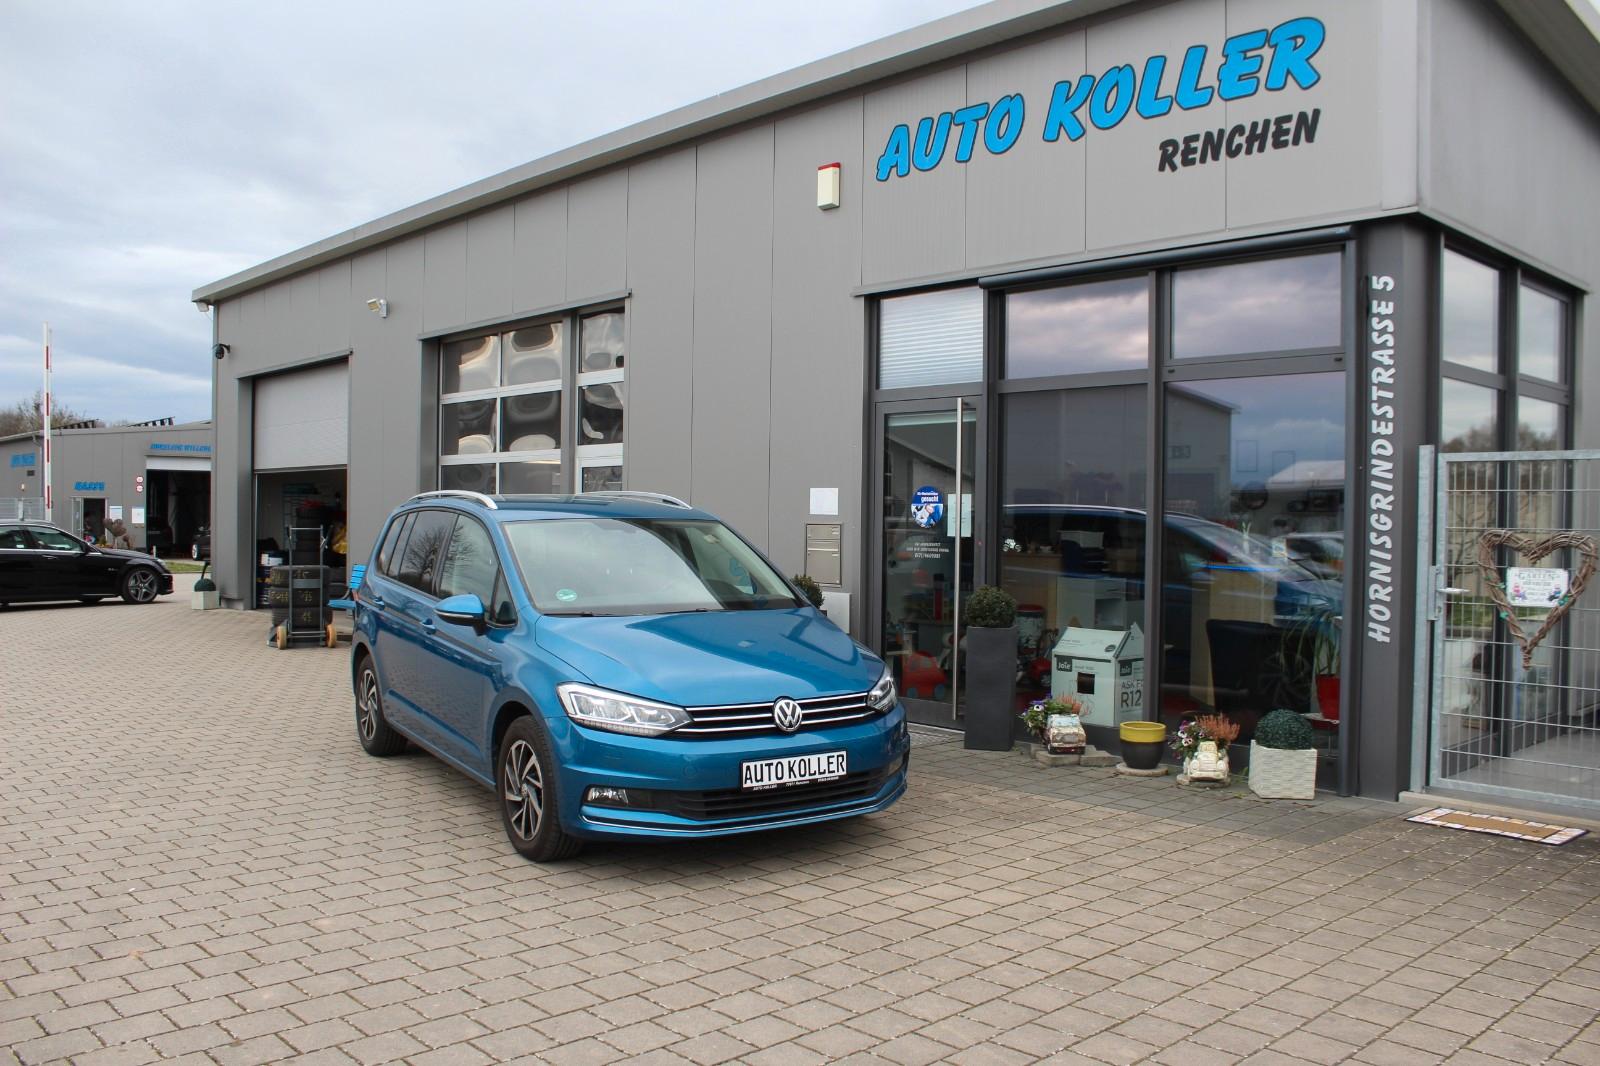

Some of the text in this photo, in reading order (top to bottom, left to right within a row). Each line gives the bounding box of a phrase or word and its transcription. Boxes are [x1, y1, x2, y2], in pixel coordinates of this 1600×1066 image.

[876, 16, 1326, 182] AUTO KOLLER
[1158, 108, 1321, 173] RENCHEN
[1367, 275, 1396, 643] HORNISGRINDESTRASSE 5
[744, 754, 845, 784] AUTO KOLLER
